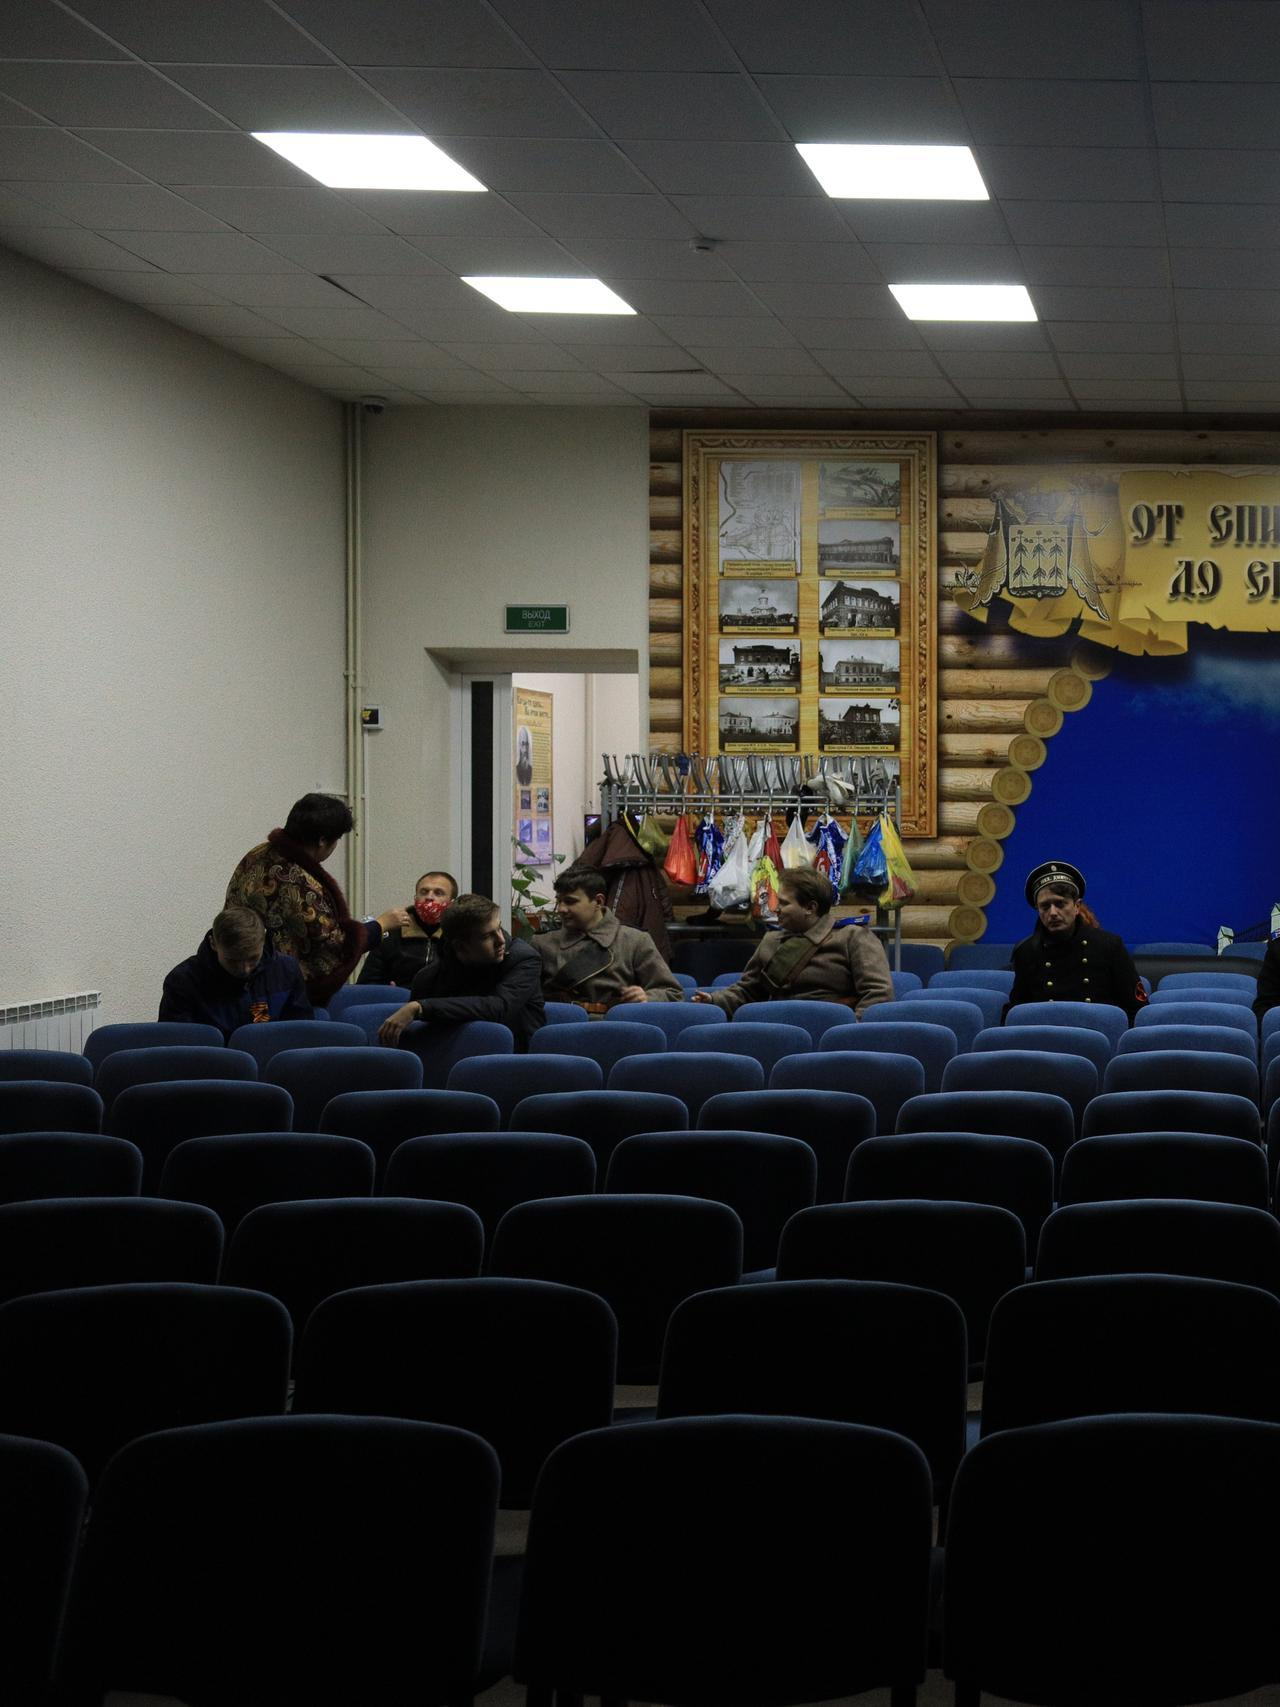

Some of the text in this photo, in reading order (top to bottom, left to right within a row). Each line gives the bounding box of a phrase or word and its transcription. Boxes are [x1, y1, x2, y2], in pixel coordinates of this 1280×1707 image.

[1131, 503, 1184, 545] ОТ
[1168, 559, 1222, 603] ДО
[522, 610, 551, 620] ВЫХОД
